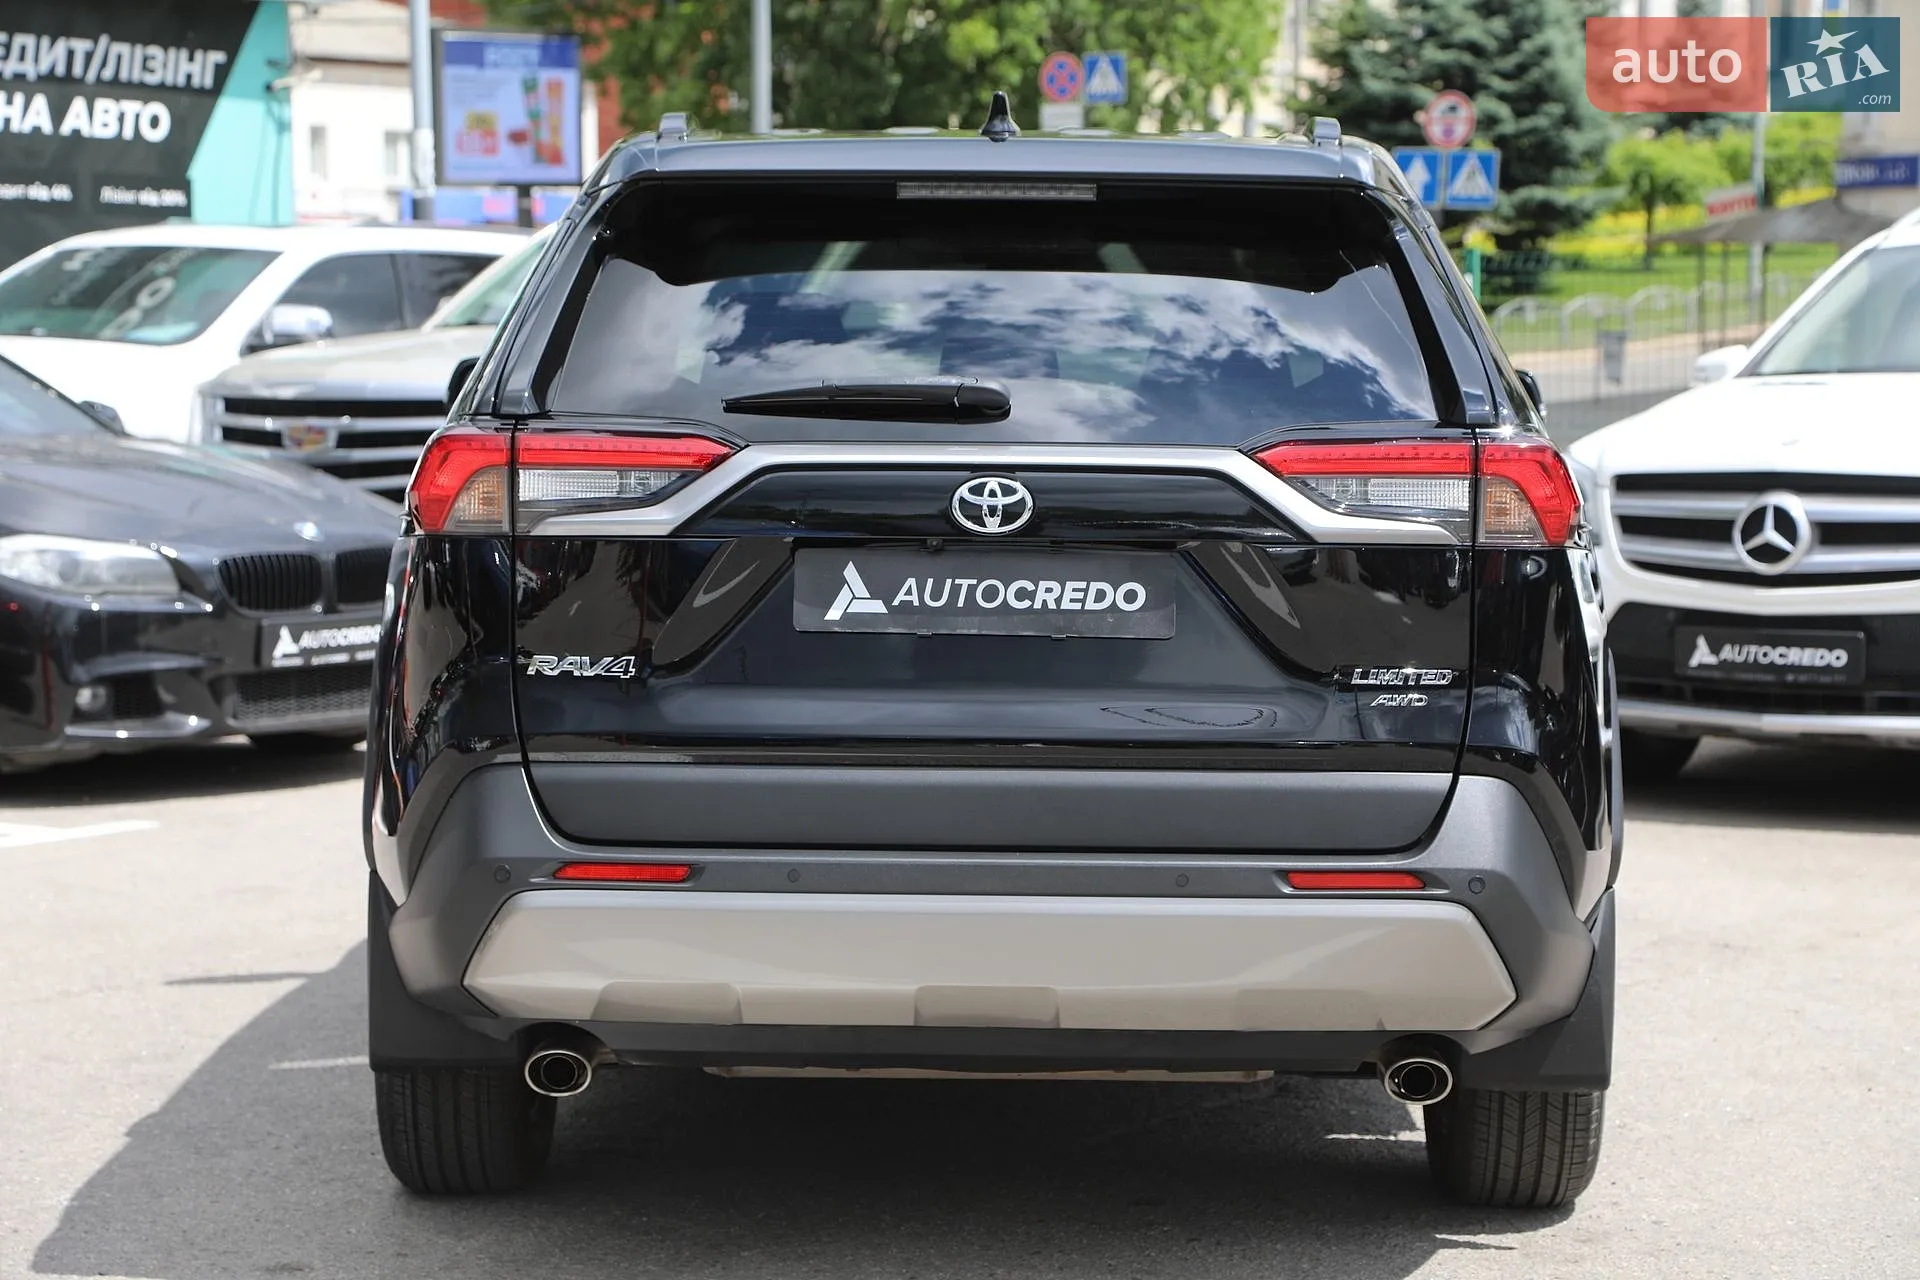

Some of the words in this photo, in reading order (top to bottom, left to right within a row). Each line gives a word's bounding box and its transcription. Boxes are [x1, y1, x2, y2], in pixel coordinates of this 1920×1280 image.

[0, 91, 54, 136] НА
[59, 95, 171, 143] АВТО
[892, 577, 1147, 612] AUTOCREDO
[526, 654, 636, 678] RAV4
[1719, 643, 1849, 668] AUTOCREDO
[1350, 668, 1453, 685] LIMITED
[1369, 694, 1428, 707] AWD
